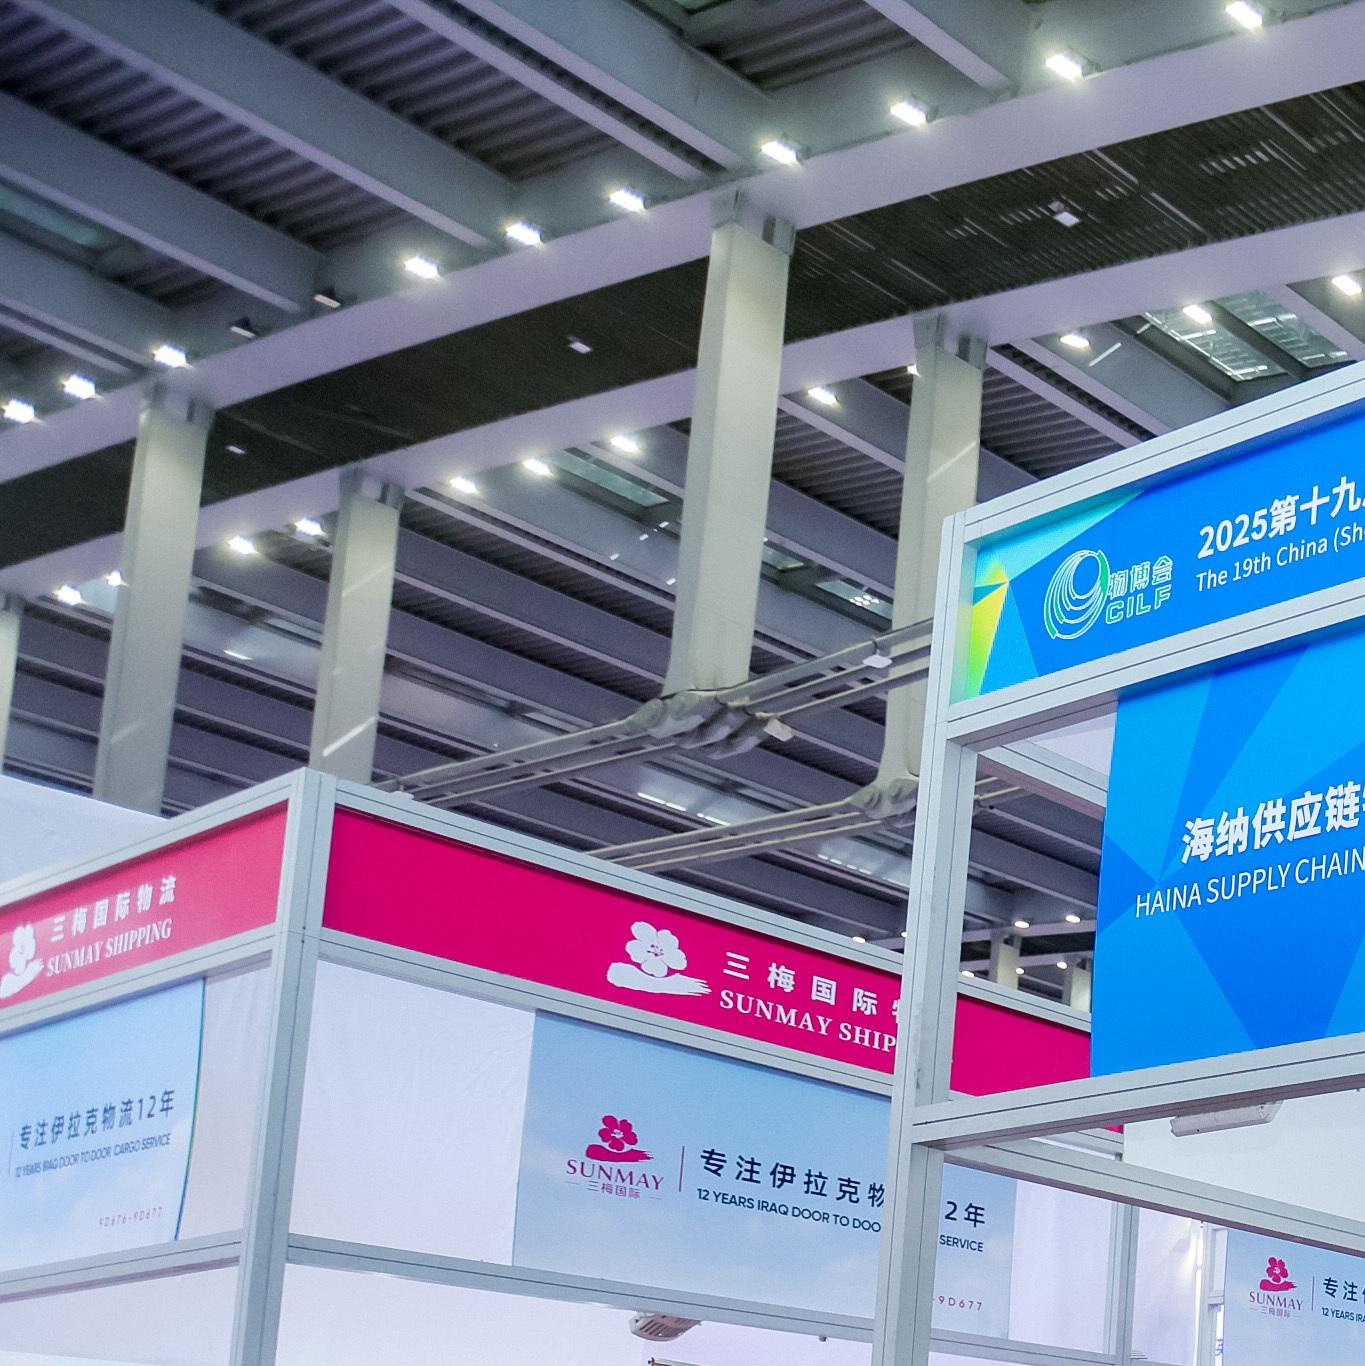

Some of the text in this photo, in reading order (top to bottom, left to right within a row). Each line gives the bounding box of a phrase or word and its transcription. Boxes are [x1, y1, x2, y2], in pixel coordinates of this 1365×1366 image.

[1107, 555, 1173, 599] 物博会
[1196, 569, 1228, 592] The
[1232, 550, 1271, 582] 19th
[1276, 535, 1328, 566] China
[1105, 584, 1172, 625] CILF
[1135, 881, 1202, 918] HAINA
[1207, 860, 1291, 903] SUPPLY
[46, 918, 173, 977] SUNMAY SHIPPING
[719, 990, 897, 1054] SUNMAY SHIP
[141, 1133, 172, 1150] SERVICE
[566, 1158, 664, 1192] SUNMAY
[697, 1188, 984, 1253] 12 YEARS IRAQ DOOR TO DOO SERVICE
[1249, 1291, 1304, 1311] SUNMAY
[1321, 1307, 1330, 1317] 12
[1331, 1309, 1354, 1322] YEARS
